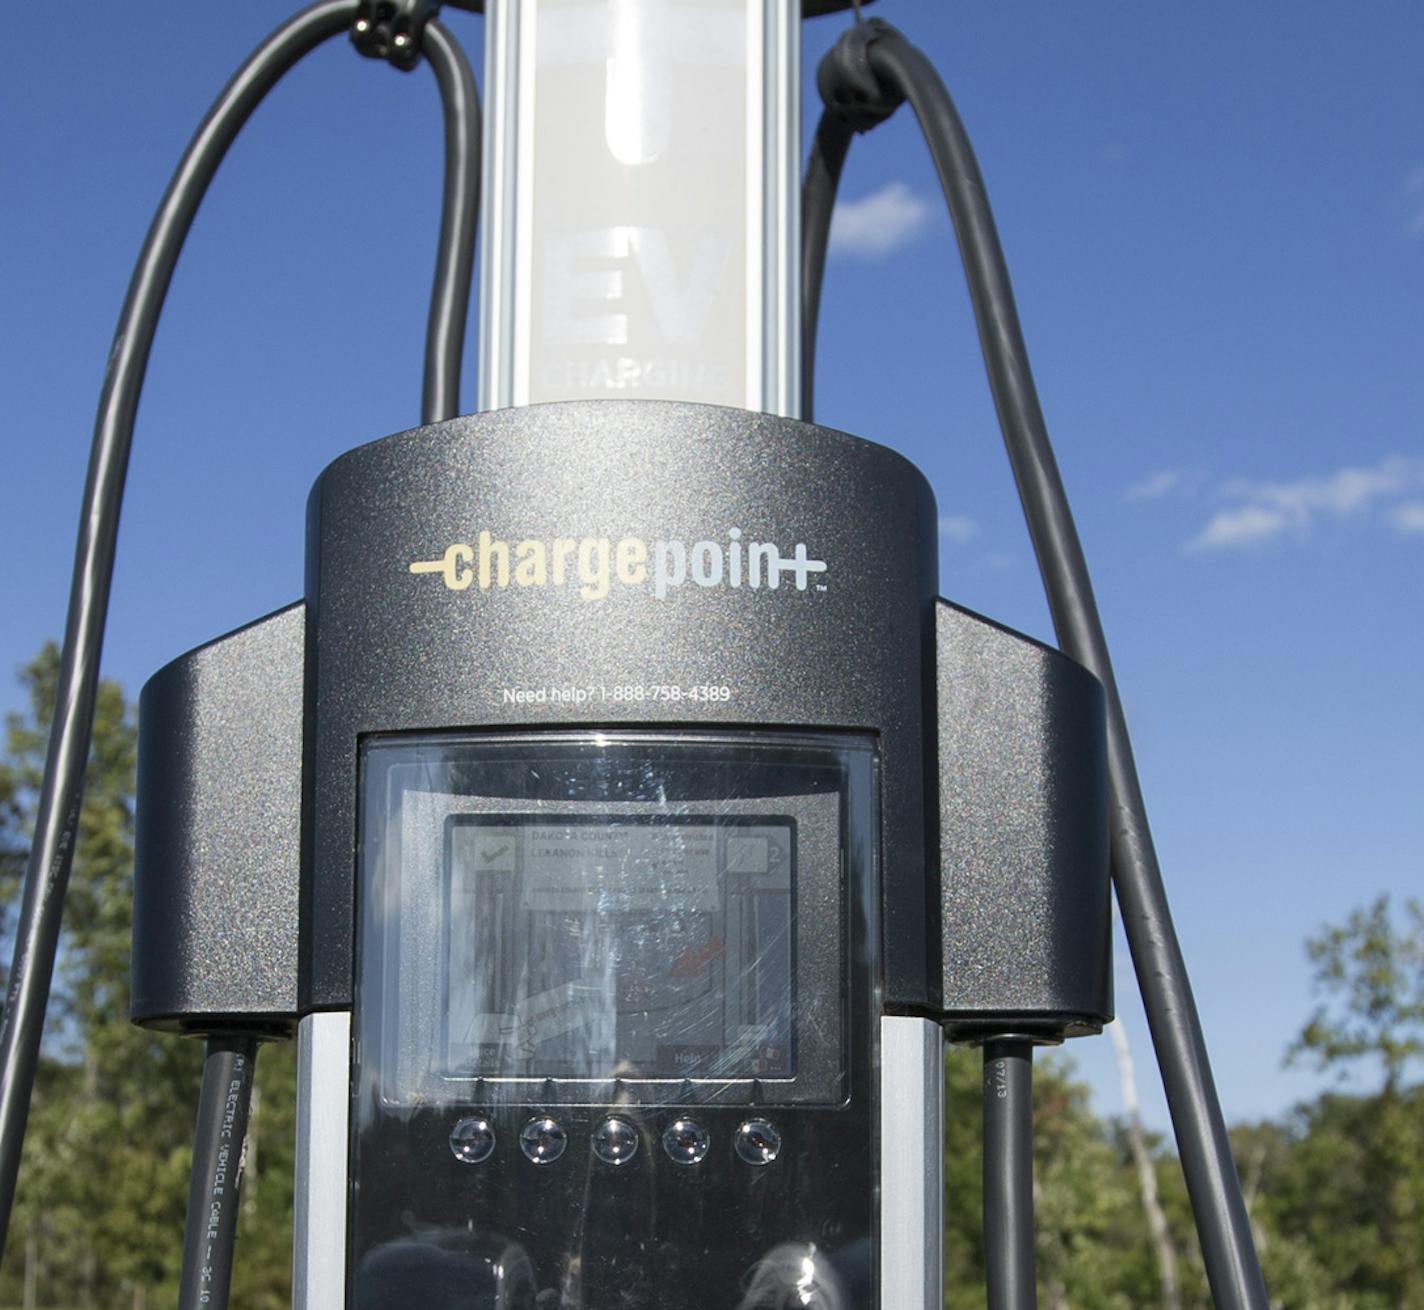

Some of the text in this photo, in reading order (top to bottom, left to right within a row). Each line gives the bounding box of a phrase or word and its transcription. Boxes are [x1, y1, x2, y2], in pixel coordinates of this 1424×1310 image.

[544, 225, 737, 346] EV
[503, 685, 731, 704] Need help? 1-888-758-4389
[996, 1060, 1008, 1099] 07/13
[219, 1080, 242, 1139] ELECTRIC
[212, 1143, 231, 1197] VEHICLE
